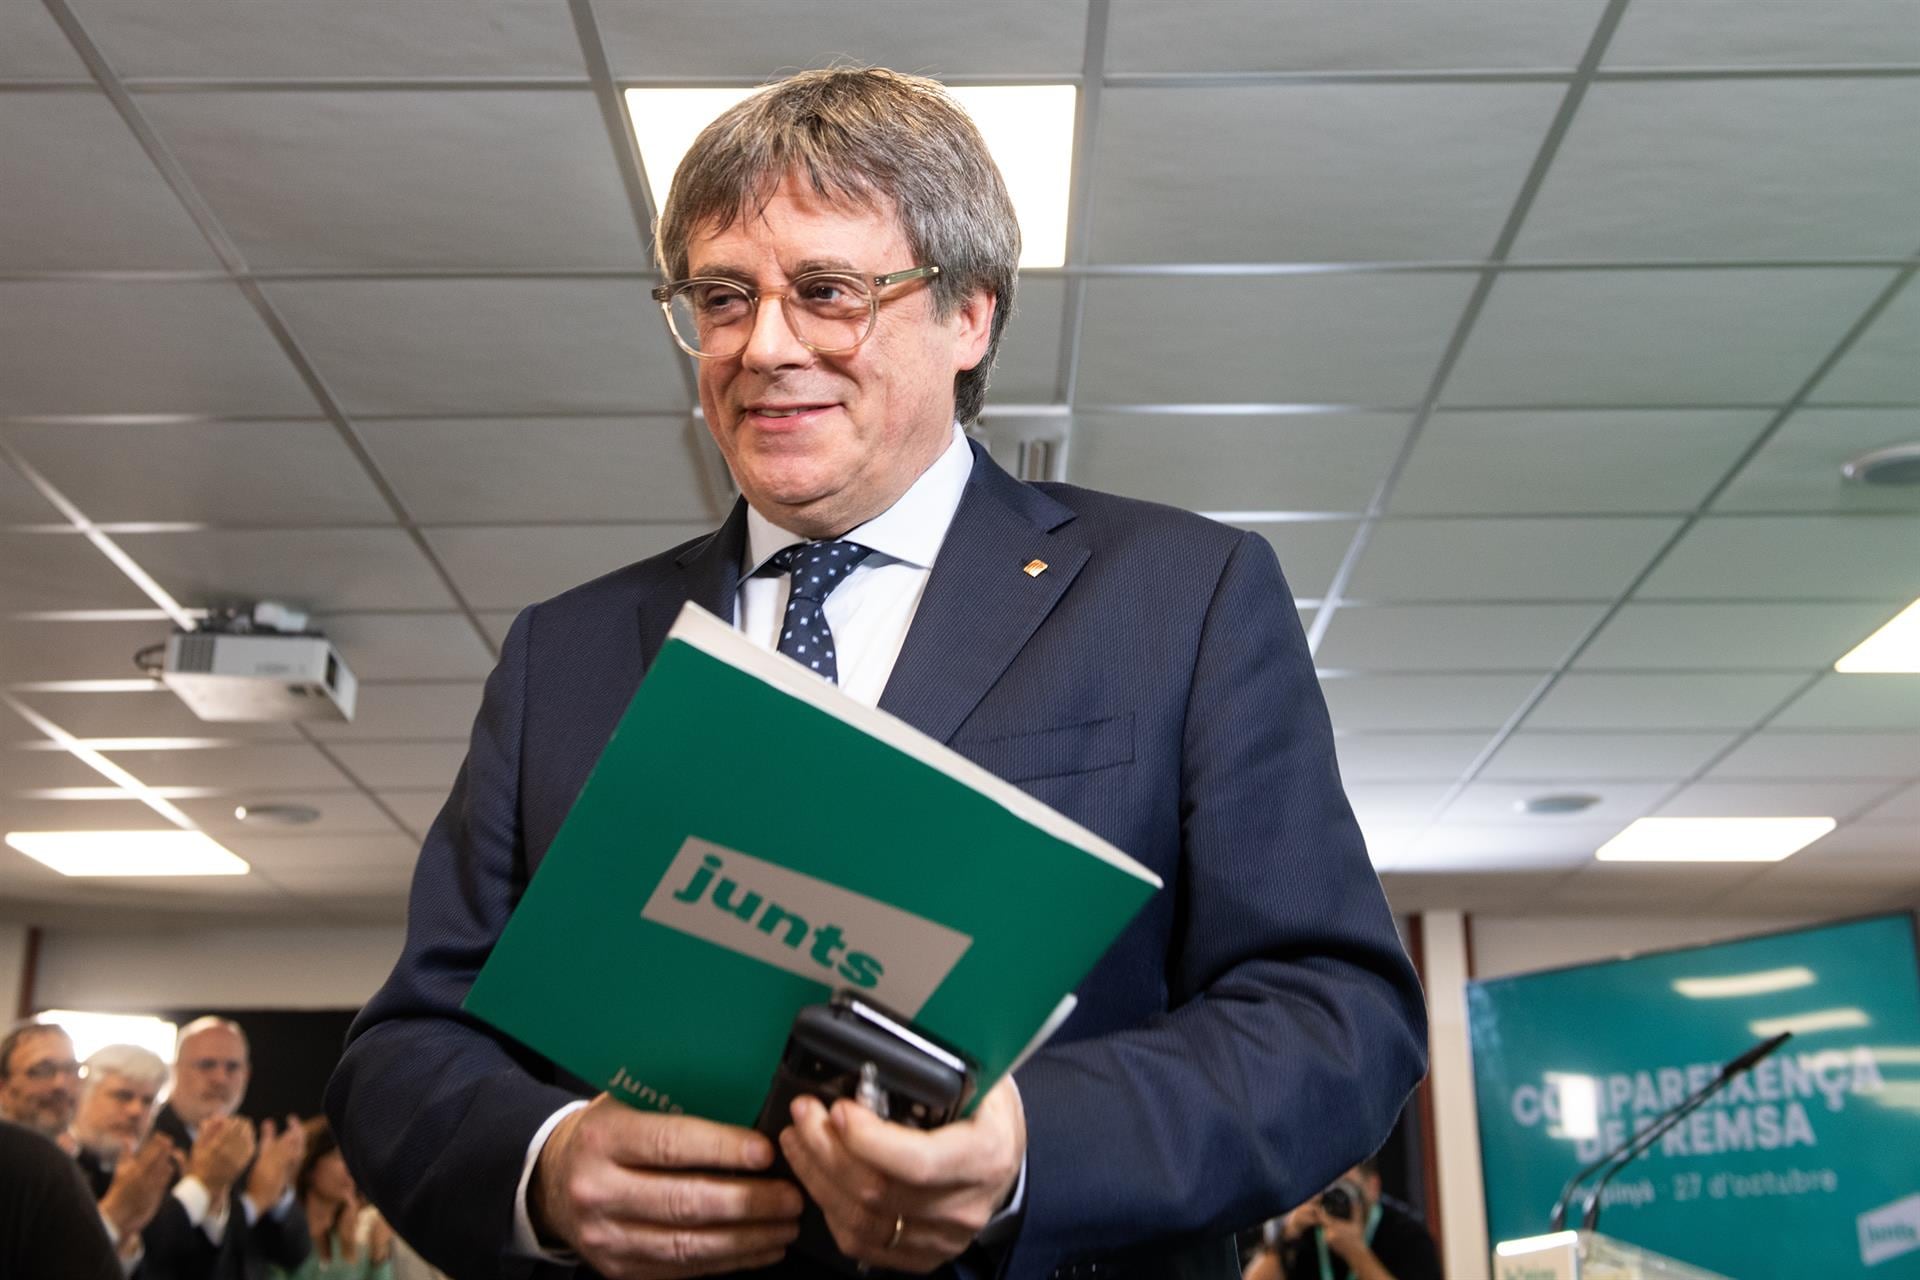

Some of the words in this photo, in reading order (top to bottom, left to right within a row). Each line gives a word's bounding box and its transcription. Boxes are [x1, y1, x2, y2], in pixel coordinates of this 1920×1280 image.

[673, 853, 885, 989] junts
[1511, 1047, 1885, 1126] COPAREIXENÇA
[1575, 1119, 1628, 1164] DE
[1673, 1172, 1701, 1202] 27
